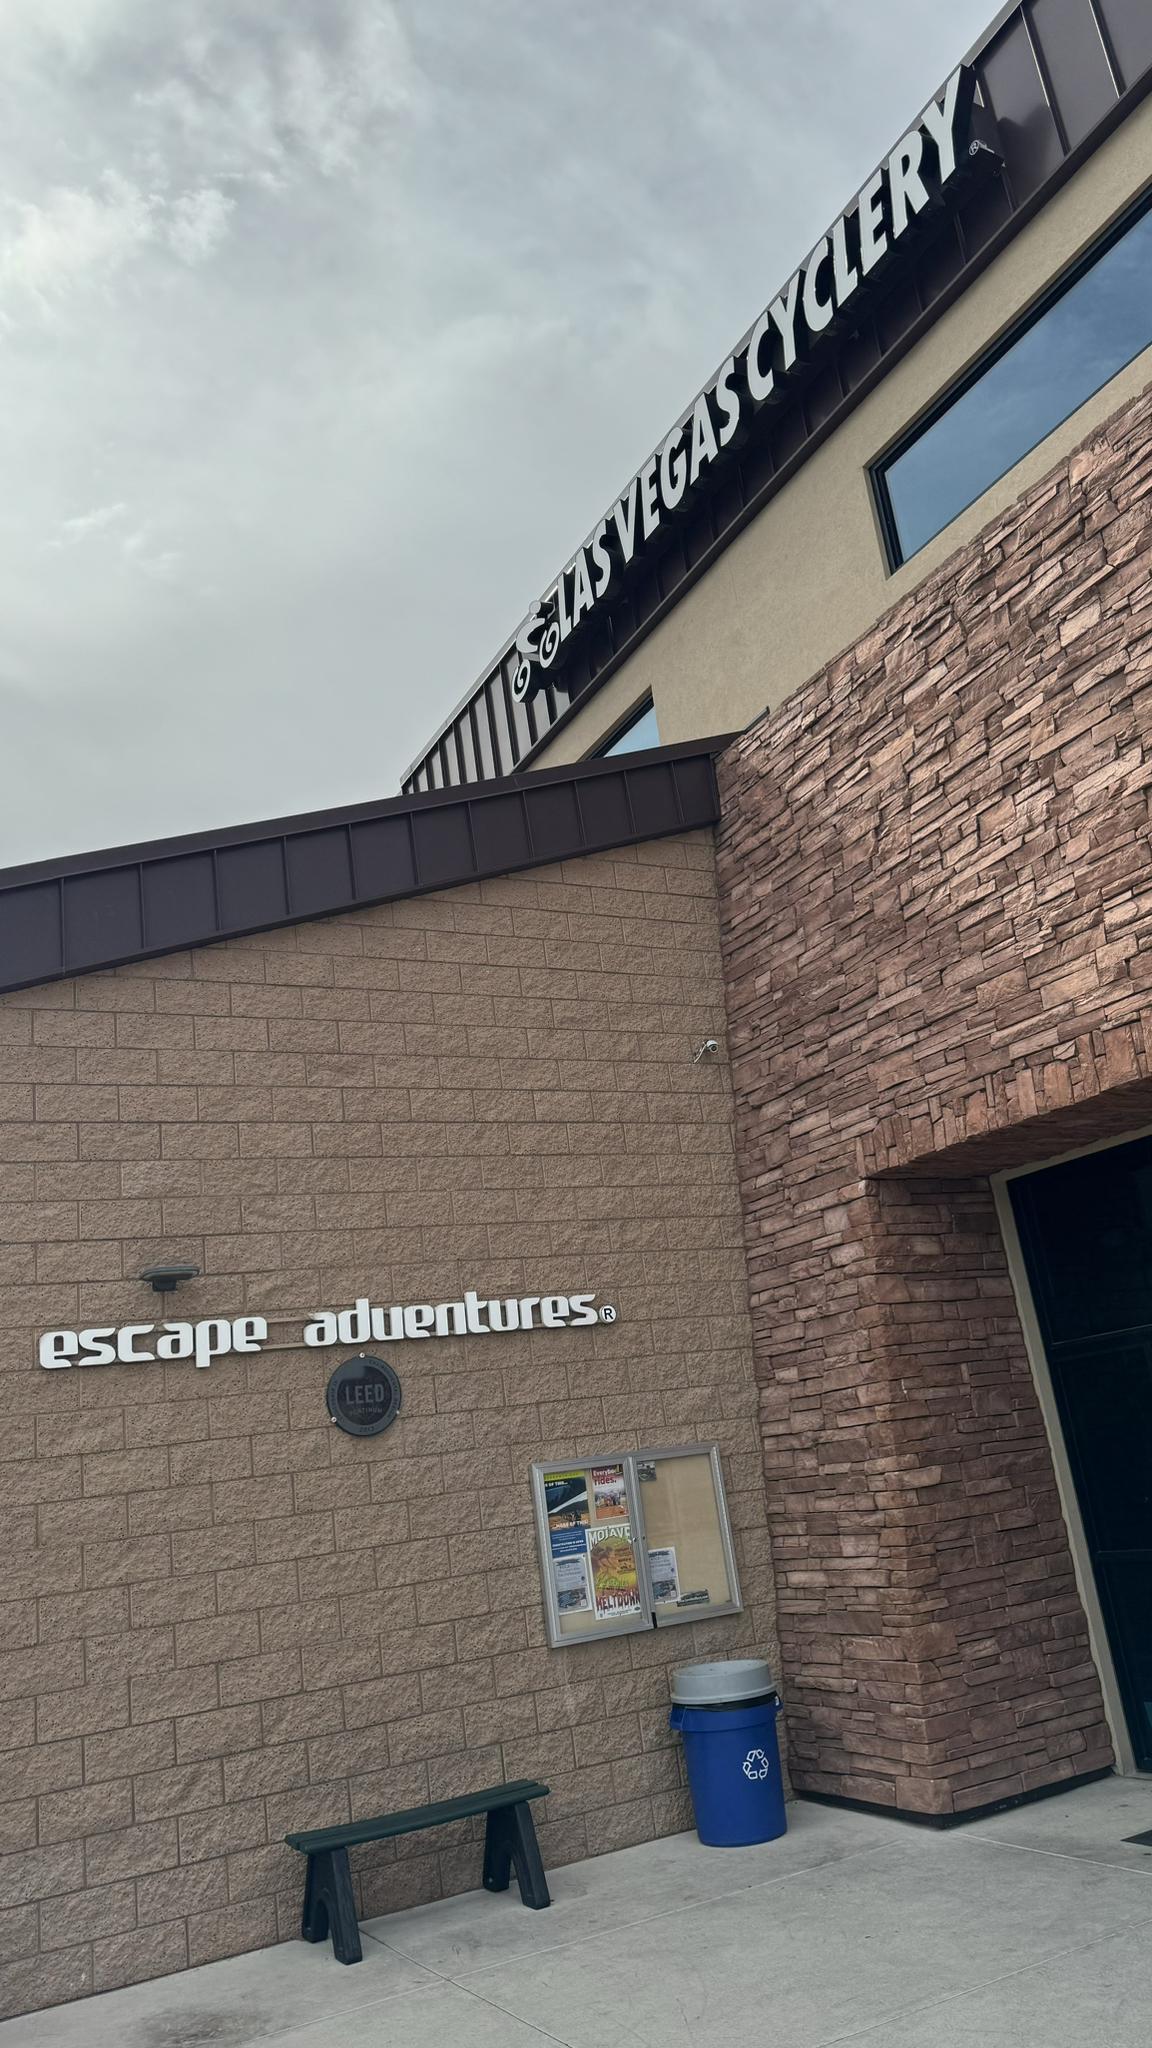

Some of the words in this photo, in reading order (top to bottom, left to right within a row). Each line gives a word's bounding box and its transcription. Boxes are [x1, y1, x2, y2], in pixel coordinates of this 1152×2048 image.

[553, 517, 612, 636] LAS
[613, 355, 740, 563] VEGAS
[746, 65, 962, 401] CYCLERY
[39, 1316, 268, 1369] escape
[345, 1383, 385, 1405] LEED
